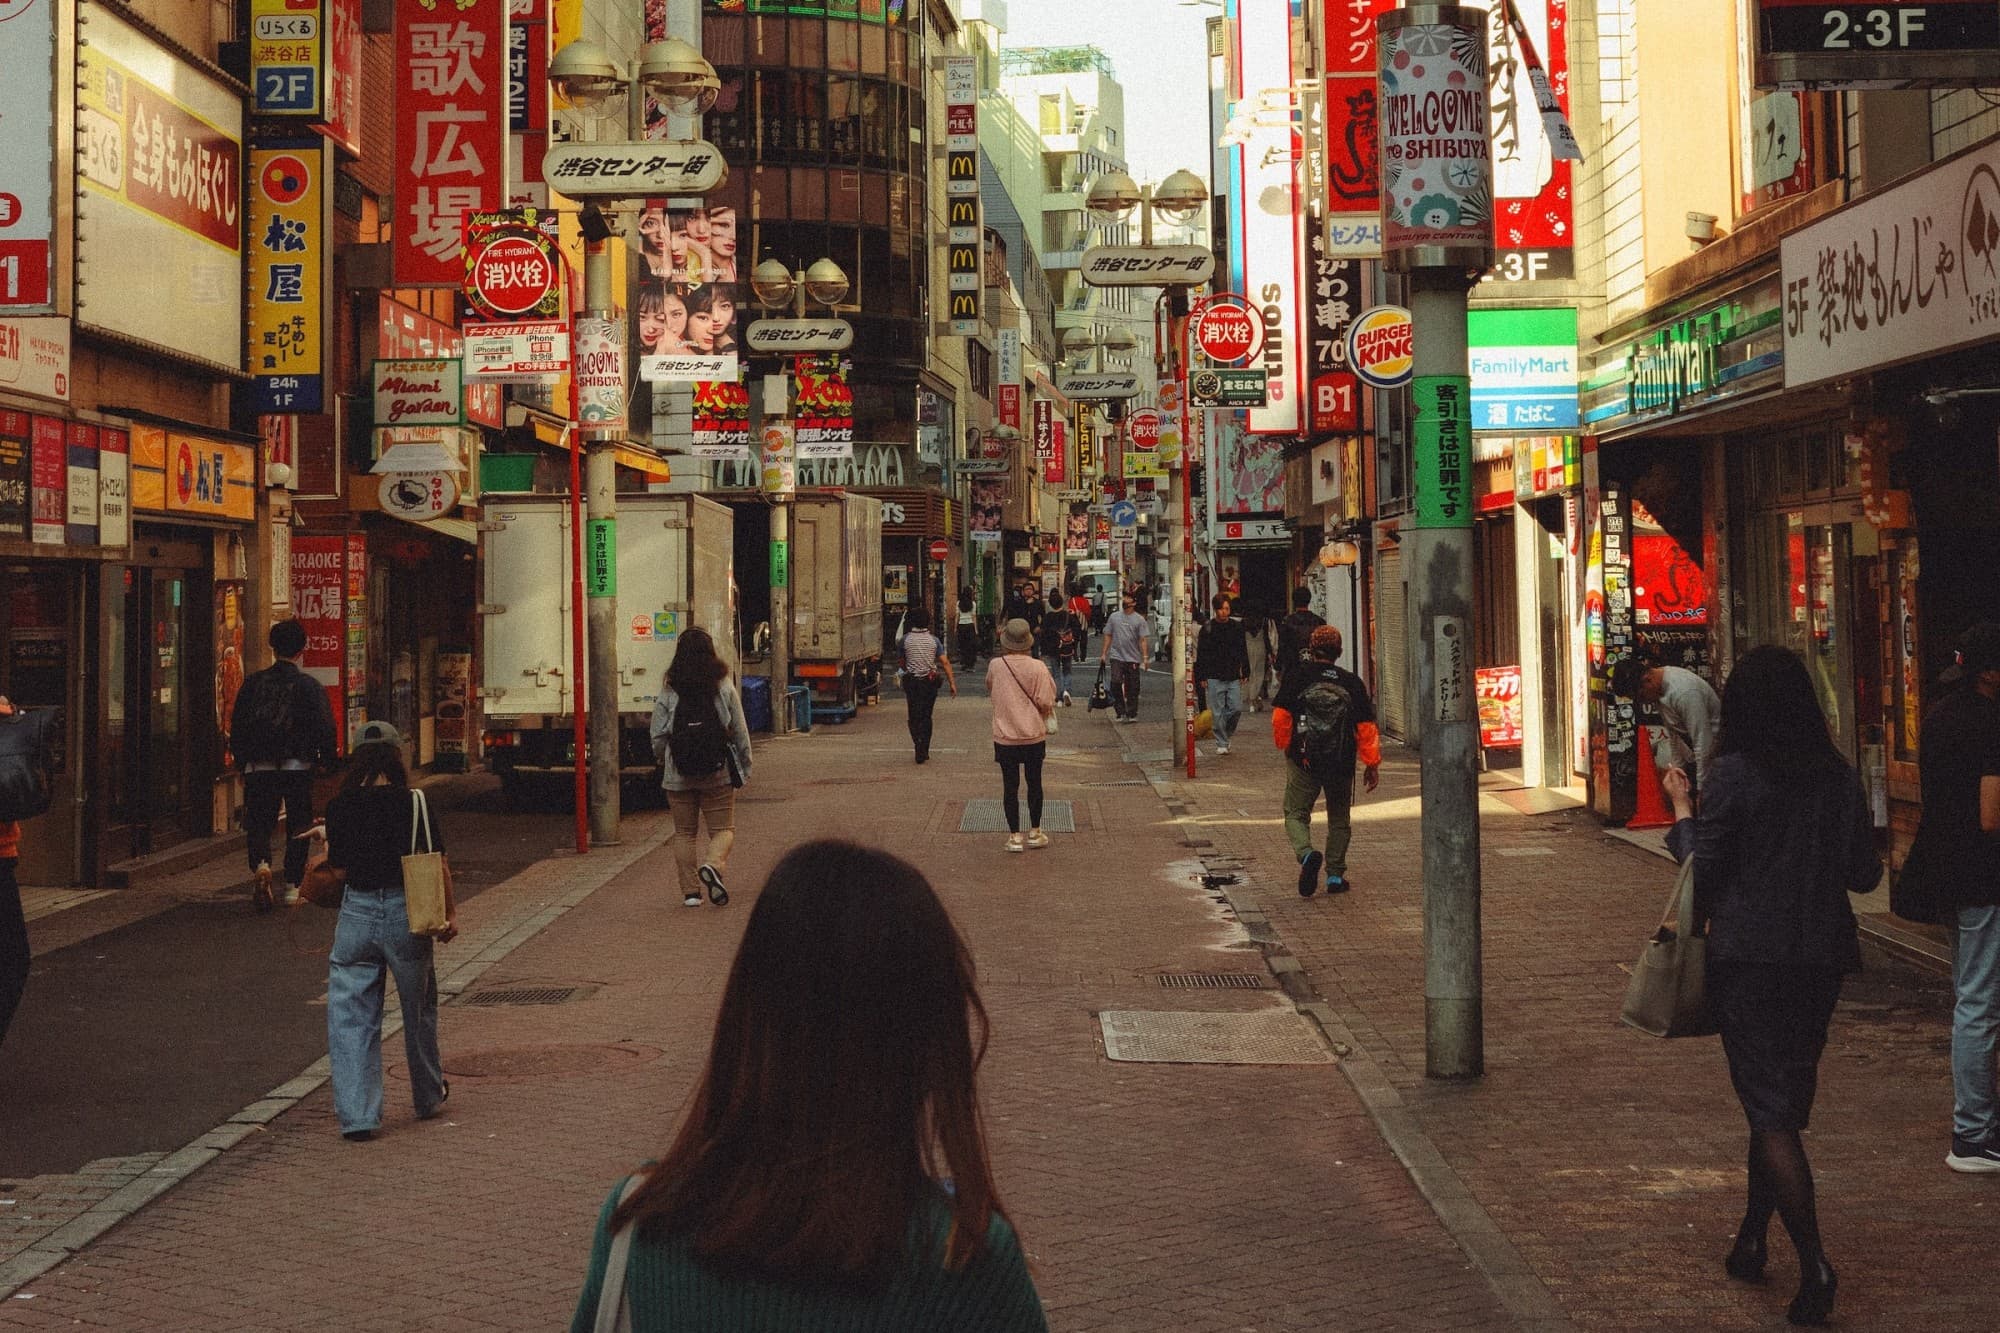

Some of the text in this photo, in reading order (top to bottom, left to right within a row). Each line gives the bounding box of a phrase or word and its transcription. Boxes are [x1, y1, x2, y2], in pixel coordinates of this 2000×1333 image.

[260, 20, 311, 35] りらくる
[260, 45, 312, 62] 渋谷店
[265, 74, 308, 102] 2F
[1386, 88, 1484, 137] WELCOME
[409, 20, 488, 263] 歌広場
[1386, 138, 1489, 161] TO SHIBUYA
[131, 101, 237, 227] 全身もみほぐし
[553, 155, 712, 177] 渋谷センター街
[262, 214, 307, 303] 松屋
[488, 247, 536, 258] FIRE HYDRANT
[1090, 256, 1207, 272] 渋谷センター街
[483, 259, 544, 291] 消火栓
[1817, 216, 1955, 348] 築地もんじゃ
[1788, 277, 1809, 338] 5F
[278, 322, 290, 362] カレー
[291, 315, 305, 356] 牛めし
[526, 335, 555, 343] iPhone
[752, 328, 846, 341] 渋谷センター街
[1203, 321, 1250, 344] 消火栓
[263, 331, 277, 369] 定食
[577, 351, 620, 376] ELCOME
[655, 361, 723, 371] 渋谷センター街
[1472, 357, 1570, 377] FamilyMart
[269, 377, 299, 389] 24h
[377, 377, 442, 395] Miami
[1063, 378, 1136, 391] 渋谷センター街
[273, 394, 294, 406] 1F
[388, 398, 457, 422] Garden
[1317, 384, 1351, 413] B1
[1487, 402, 1557, 425] 酒 たばこ
[1436, 384, 1459, 518] 客引きは犯罪です
[197, 450, 223, 505] 松屋
[292, 552, 341, 568] ARAOKE
[291, 573, 341, 584] ラオケルーム
